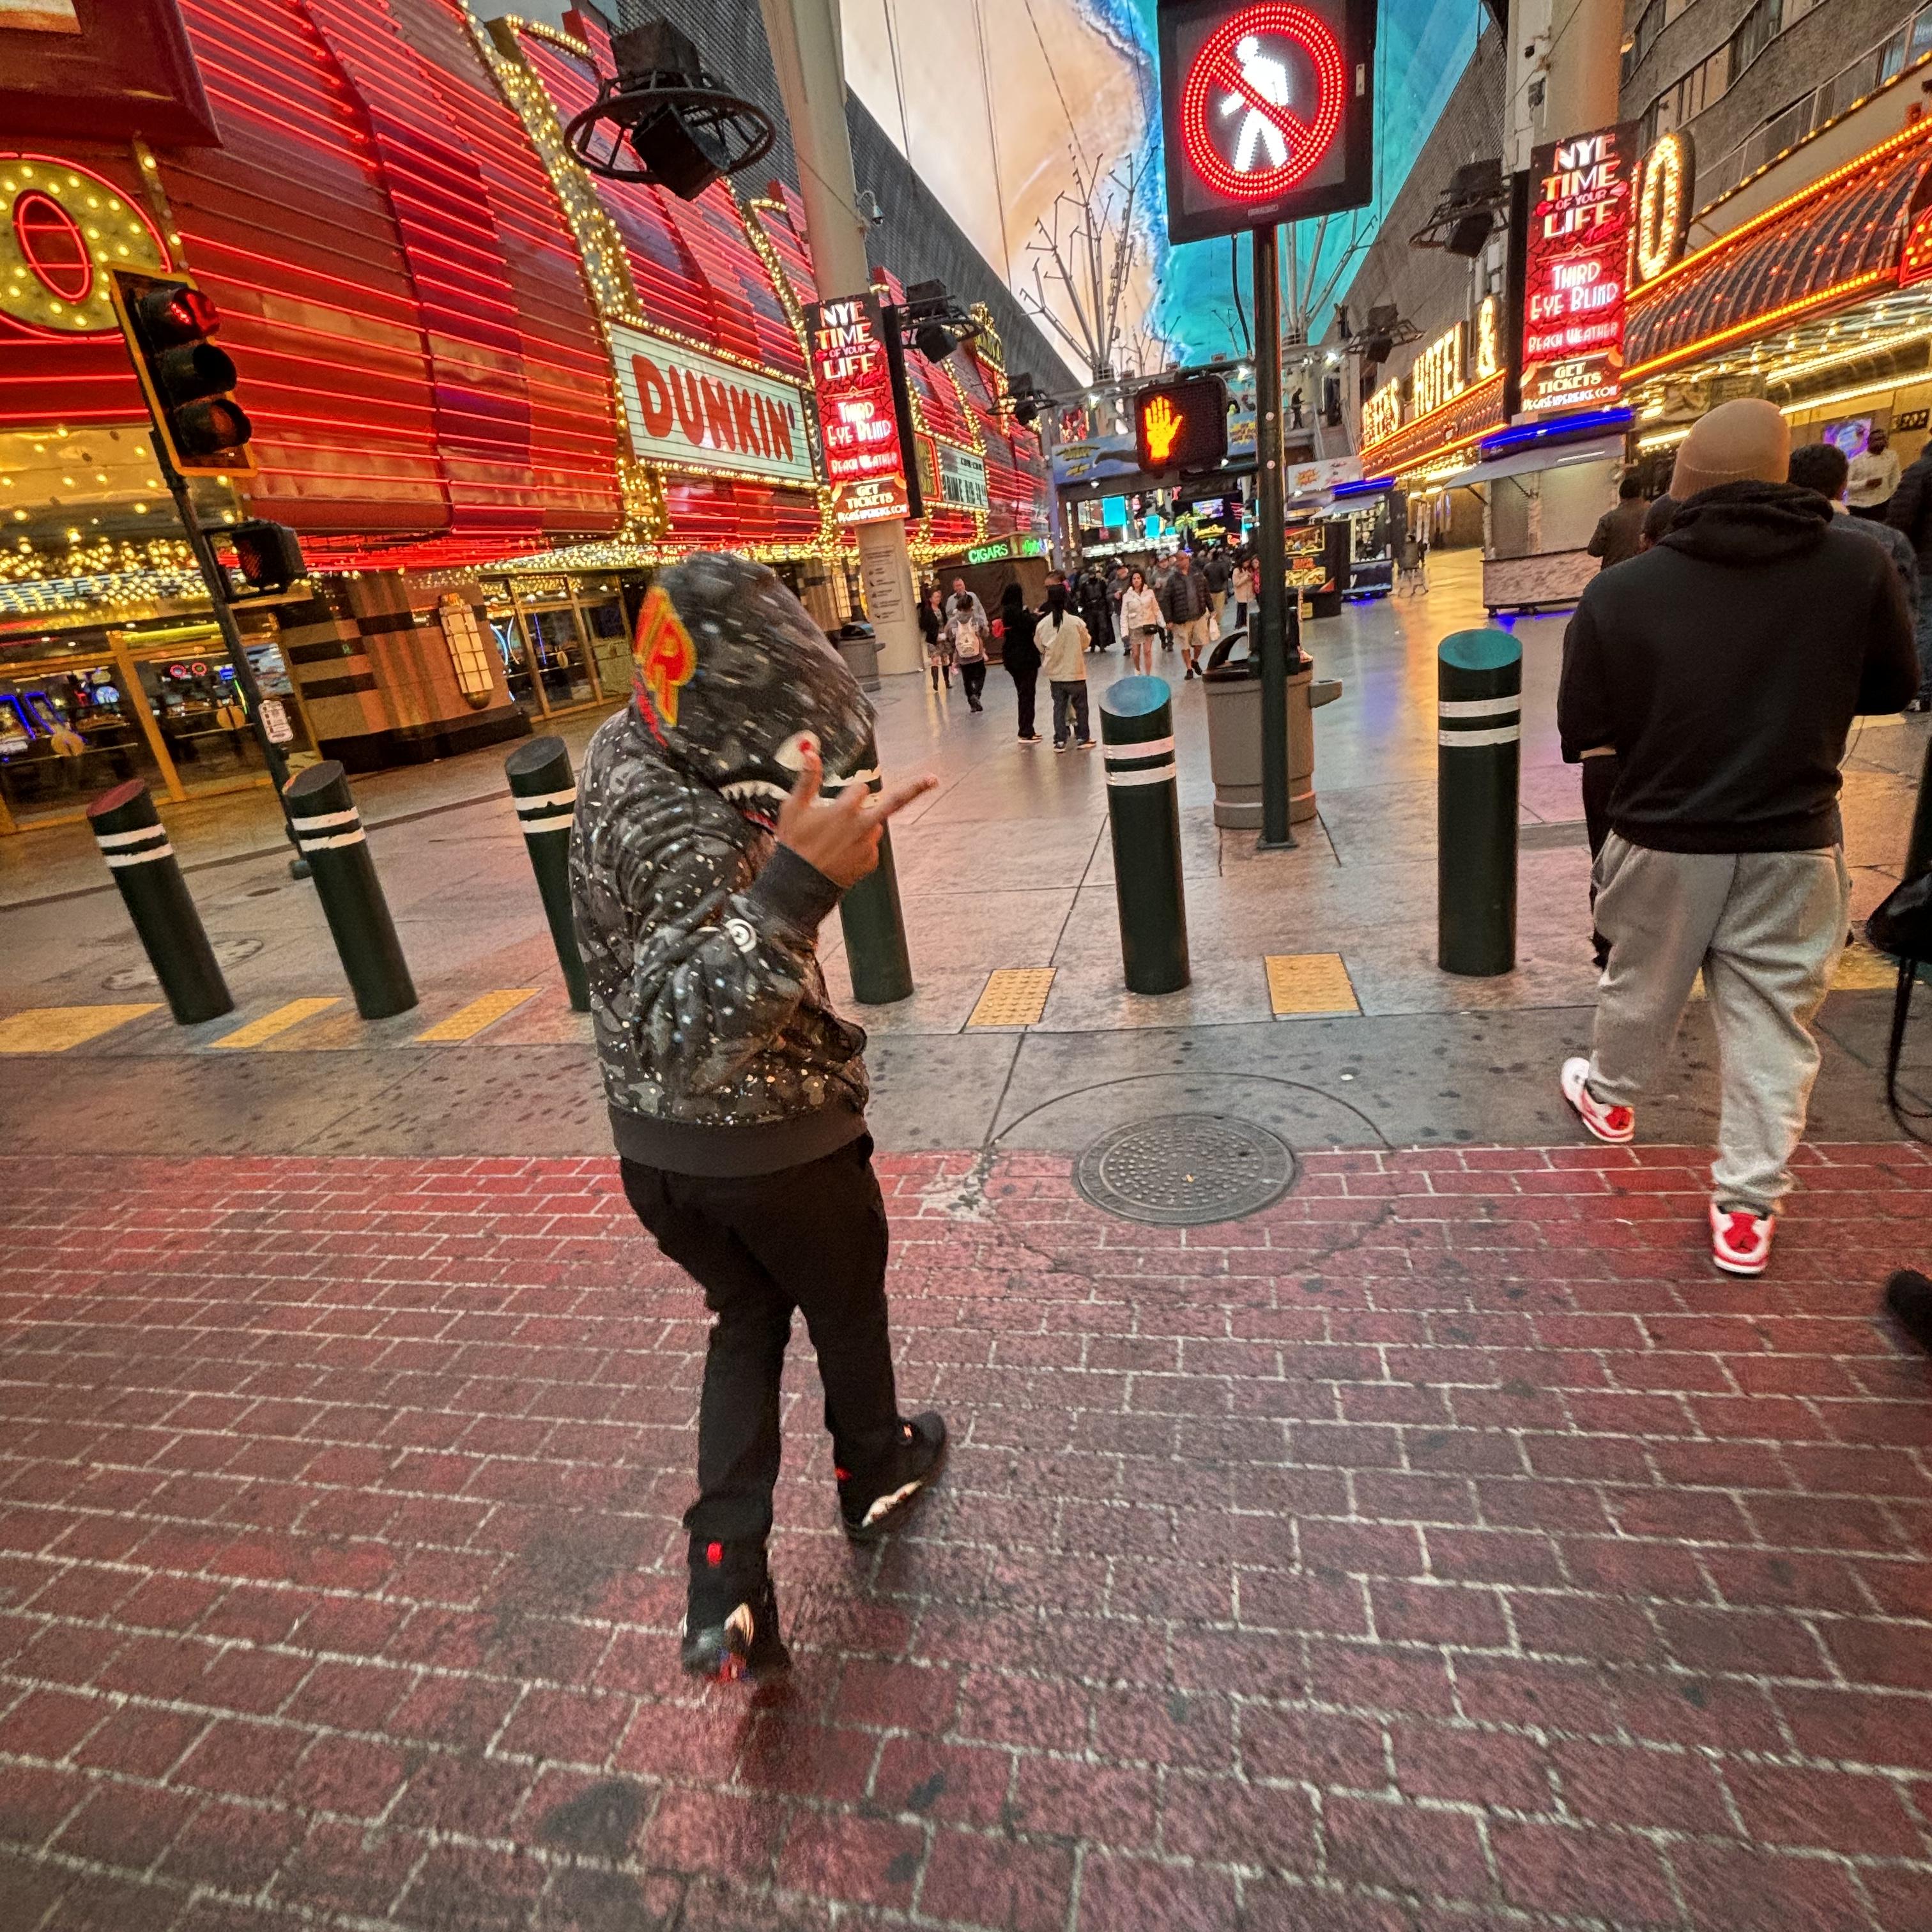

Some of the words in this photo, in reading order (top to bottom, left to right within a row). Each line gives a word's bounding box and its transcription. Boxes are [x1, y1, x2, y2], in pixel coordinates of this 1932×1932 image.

[1553, 134, 1617, 172] NYE
[1541, 160, 1621, 201] TIME
[1555, 197, 1573, 211] OF
[1575, 189, 1607, 206] YOUR
[1544, 197, 1619, 238] LIFE
[1552, 261, 1600, 290] THIRD
[820, 300, 869, 327] NYE
[1531, 294, 1564, 321] EYE
[1570, 282, 1618, 312] BLIND
[815, 322, 874, 350] TIME
[1528, 333, 1563, 353] BEACH
[1567, 322, 1618, 344] WEATHER
[829, 348, 841, 358] OF
[843, 344, 866, 355] YOUR
[822, 353, 878, 380] LIFE
[1554, 362, 1586, 379] GET
[1538, 372, 1602, 395] TICKETS
[631, 354, 795, 462] DUNKIN'
[827, 425, 854, 446] EYE
[845, 493, 894, 509] TICKETS
[856, 484, 879, 497] GET
[968, 543, 1009, 564] CIGARS
